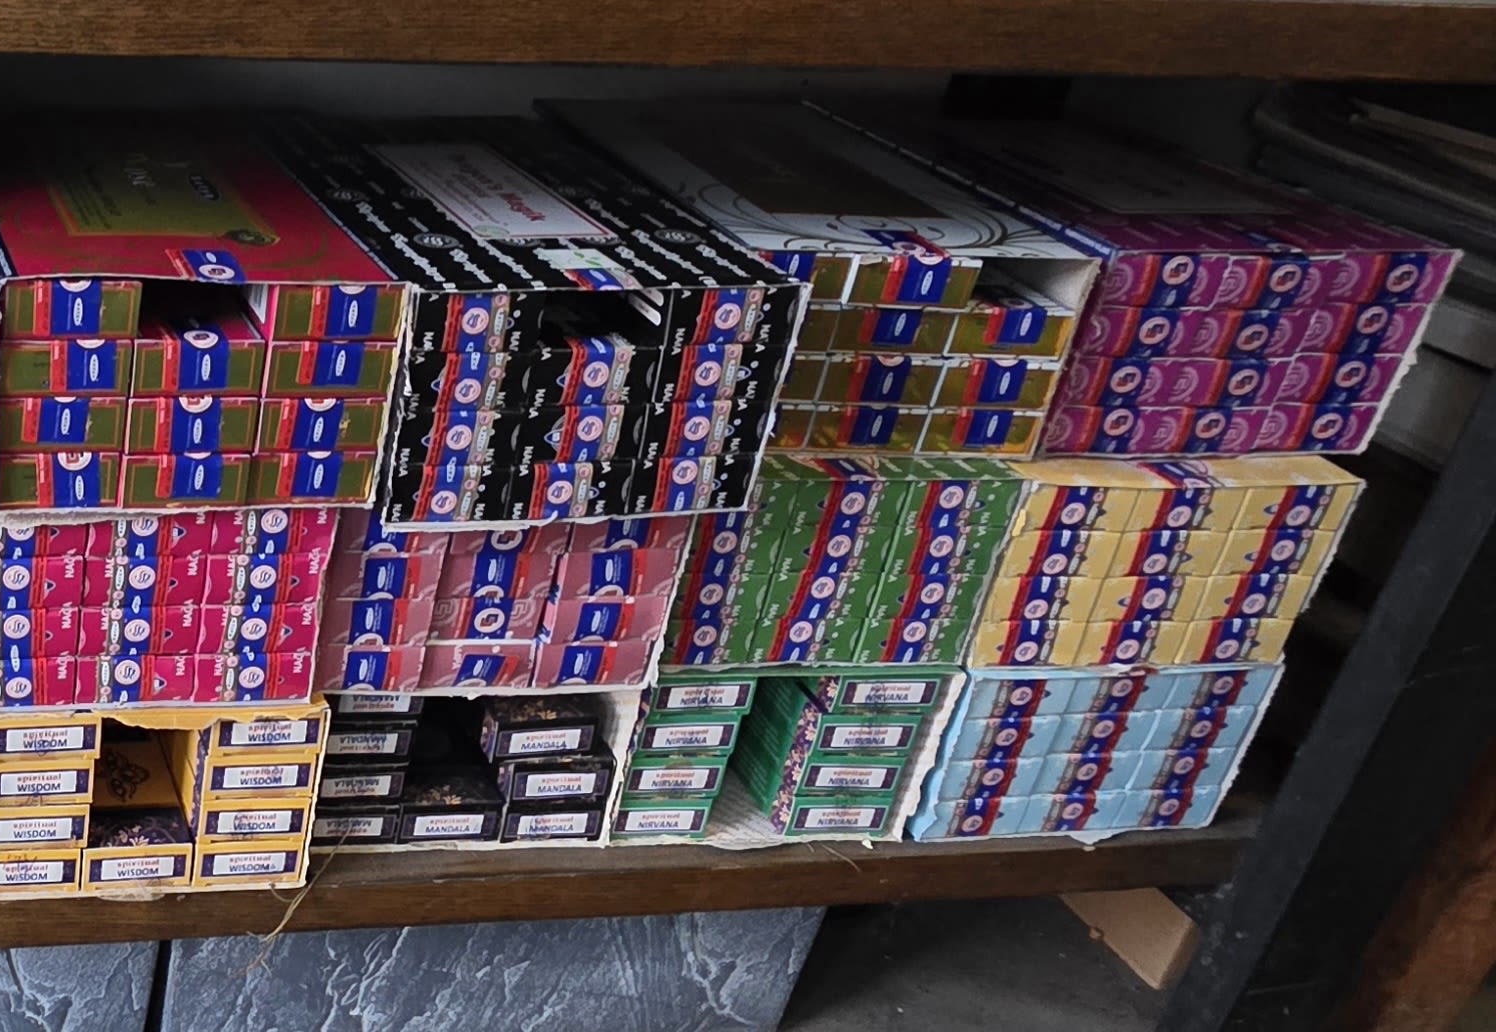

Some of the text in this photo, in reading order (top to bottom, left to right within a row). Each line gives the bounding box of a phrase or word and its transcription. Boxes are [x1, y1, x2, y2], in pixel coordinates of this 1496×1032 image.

[680, 696, 724, 706] NIRVANA
[248, 732, 291, 742] WISDOM
[664, 736, 708, 746] NIRVANA
[843, 736, 886, 746] NIRVANA
[520, 740, 568, 750] MANDALA
[240, 776, 282, 786] WISDOM
[650, 778, 694, 788] NIRVANA
[828, 778, 870, 787] NIRVANA
[17, 782, 61, 792] WISDOM
[537, 783, 582, 794] MANDALA
[637, 820, 680, 830] NIRVANA
[817, 818, 859, 827] NIRVANA
[13, 829, 57, 839] WISDOM
[425, 824, 470, 834] MANDALA
[117, 867, 159, 877] WISDOM
[228, 864, 271, 873] WISDOM
[5, 872, 48, 882] WISDOM
